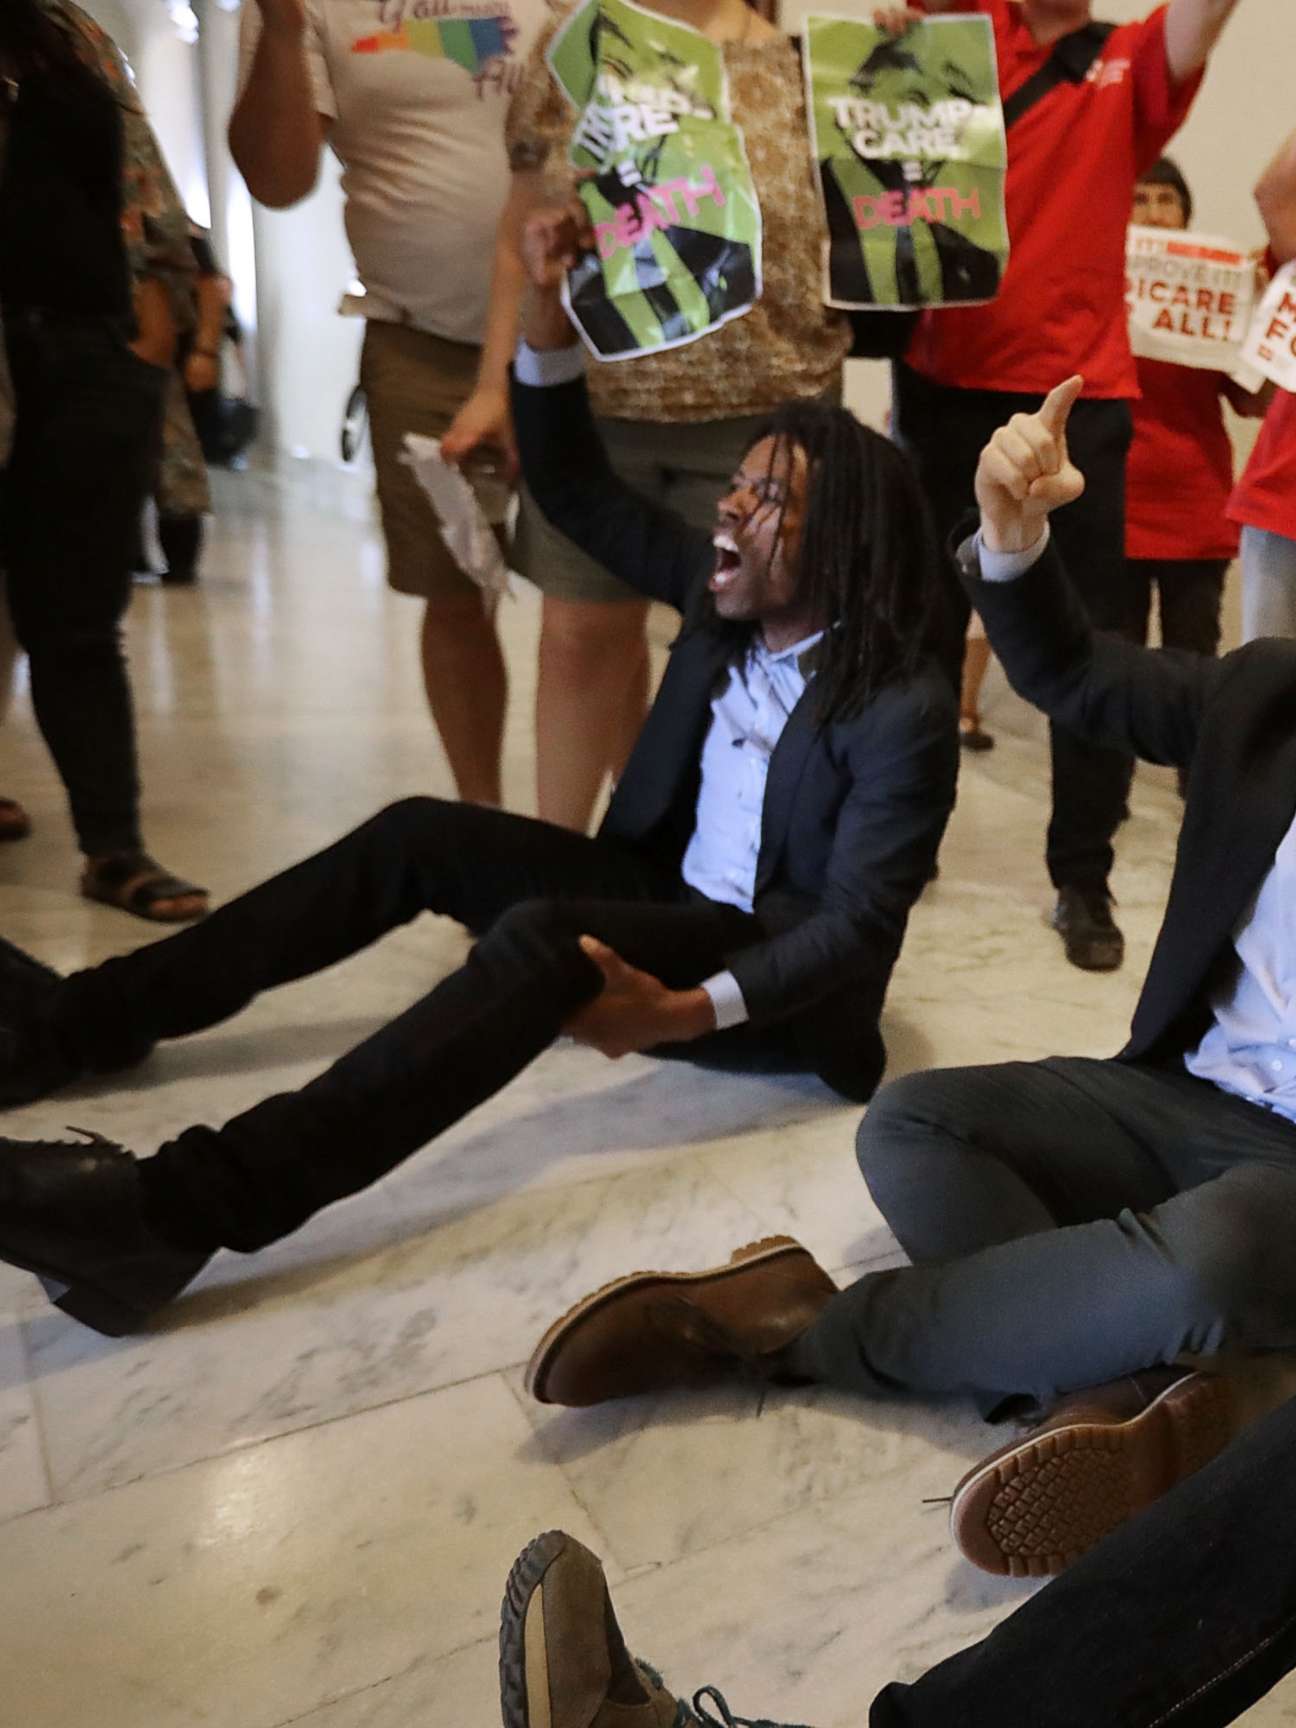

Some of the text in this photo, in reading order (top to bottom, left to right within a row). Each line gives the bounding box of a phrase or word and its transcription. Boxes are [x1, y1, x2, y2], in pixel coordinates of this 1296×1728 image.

[826, 95, 973, 130] TRUMP
[854, 130, 971, 160] CARE
[594, 162, 726, 260] DEATH
[852, 187, 983, 230] DEATH
[1138, 276, 1236, 315] ICARE
[1152, 307, 1232, 342] ALL!
